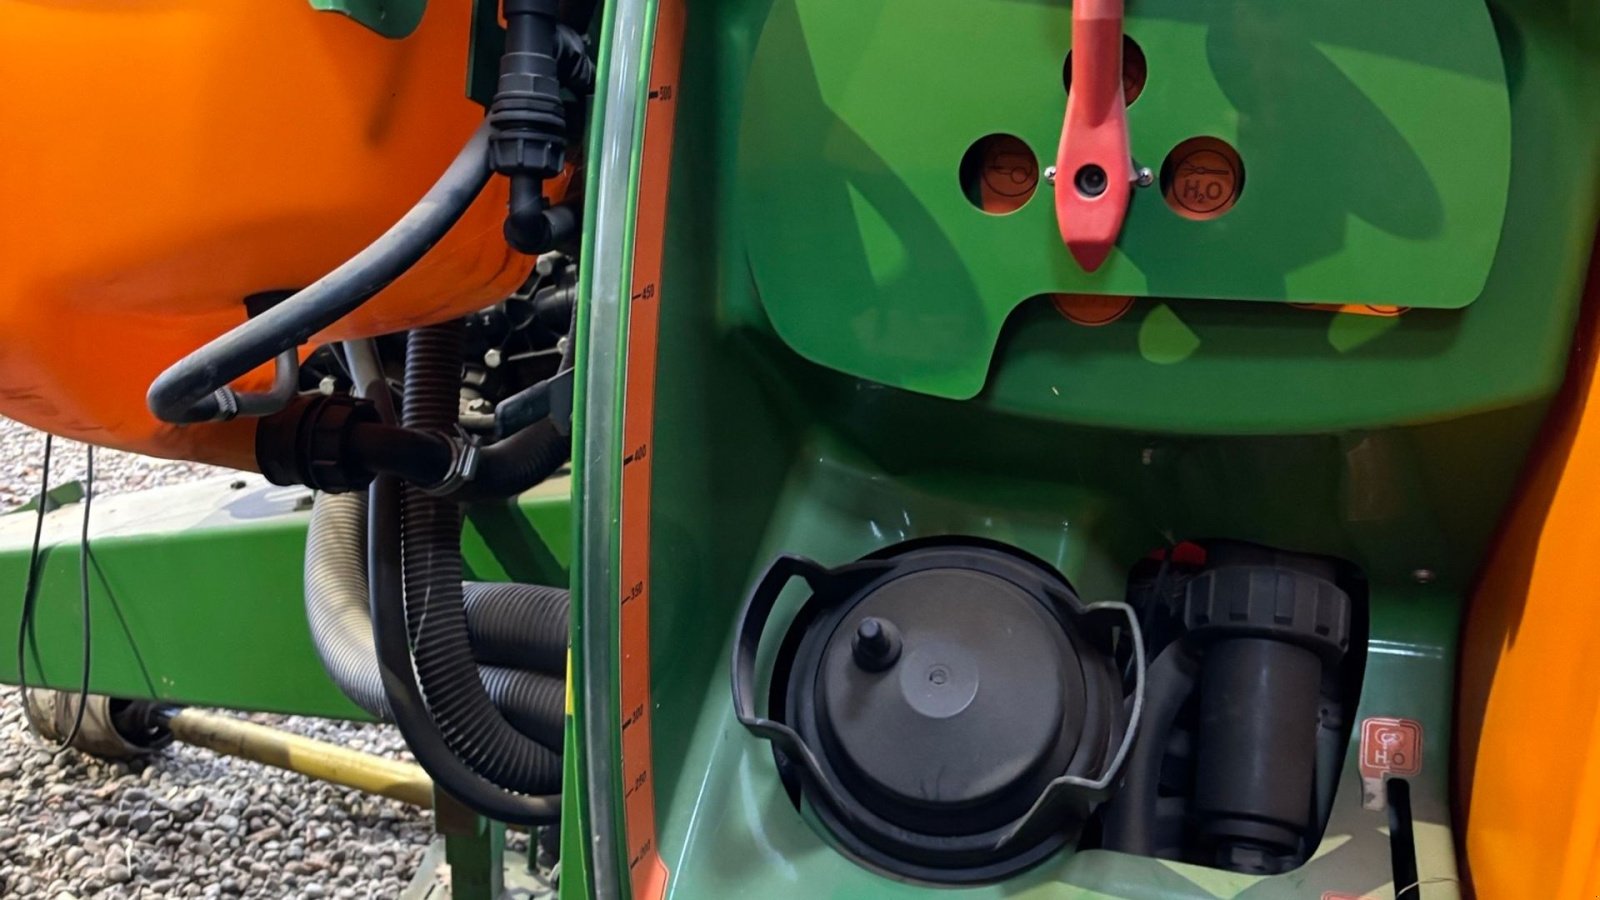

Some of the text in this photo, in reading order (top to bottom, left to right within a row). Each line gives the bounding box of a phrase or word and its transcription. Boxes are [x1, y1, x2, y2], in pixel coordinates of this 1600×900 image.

[660, 86, 671, 101] 500
[642, 283, 654, 300] 450
[634, 444, 646, 461] 400
[630, 580, 643, 600] 350
[632, 703, 644, 724] 300
